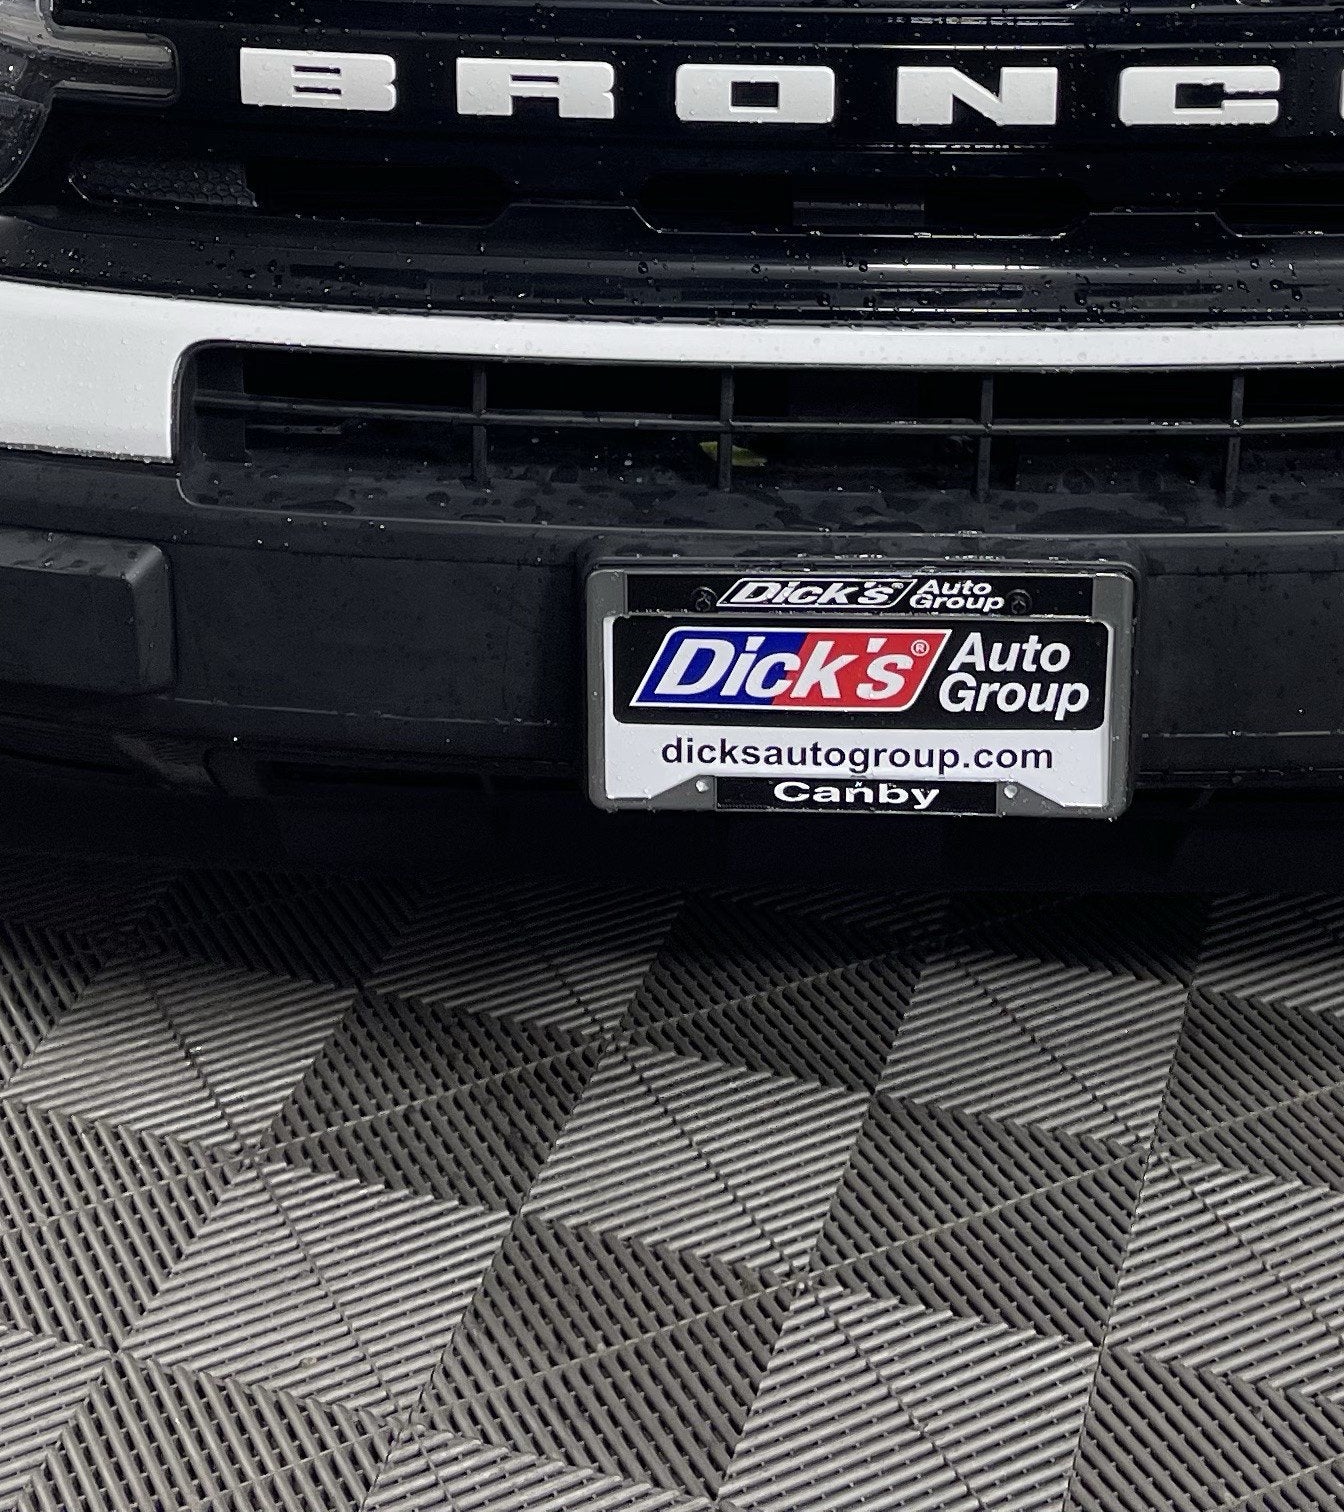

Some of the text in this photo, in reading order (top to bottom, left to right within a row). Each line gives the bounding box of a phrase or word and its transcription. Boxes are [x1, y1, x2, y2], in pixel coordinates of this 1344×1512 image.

[729, 580, 896, 606] Dick's
[908, 592, 1006, 612] Group
[916, 578, 993, 596] Auto
[653, 635, 913, 701] Dick's
[948, 631, 1072, 674] Auto
[938, 674, 1091, 721] Group
[660, 737, 1054, 774] dicksautogroup.com
[773, 781, 941, 811] Canby
